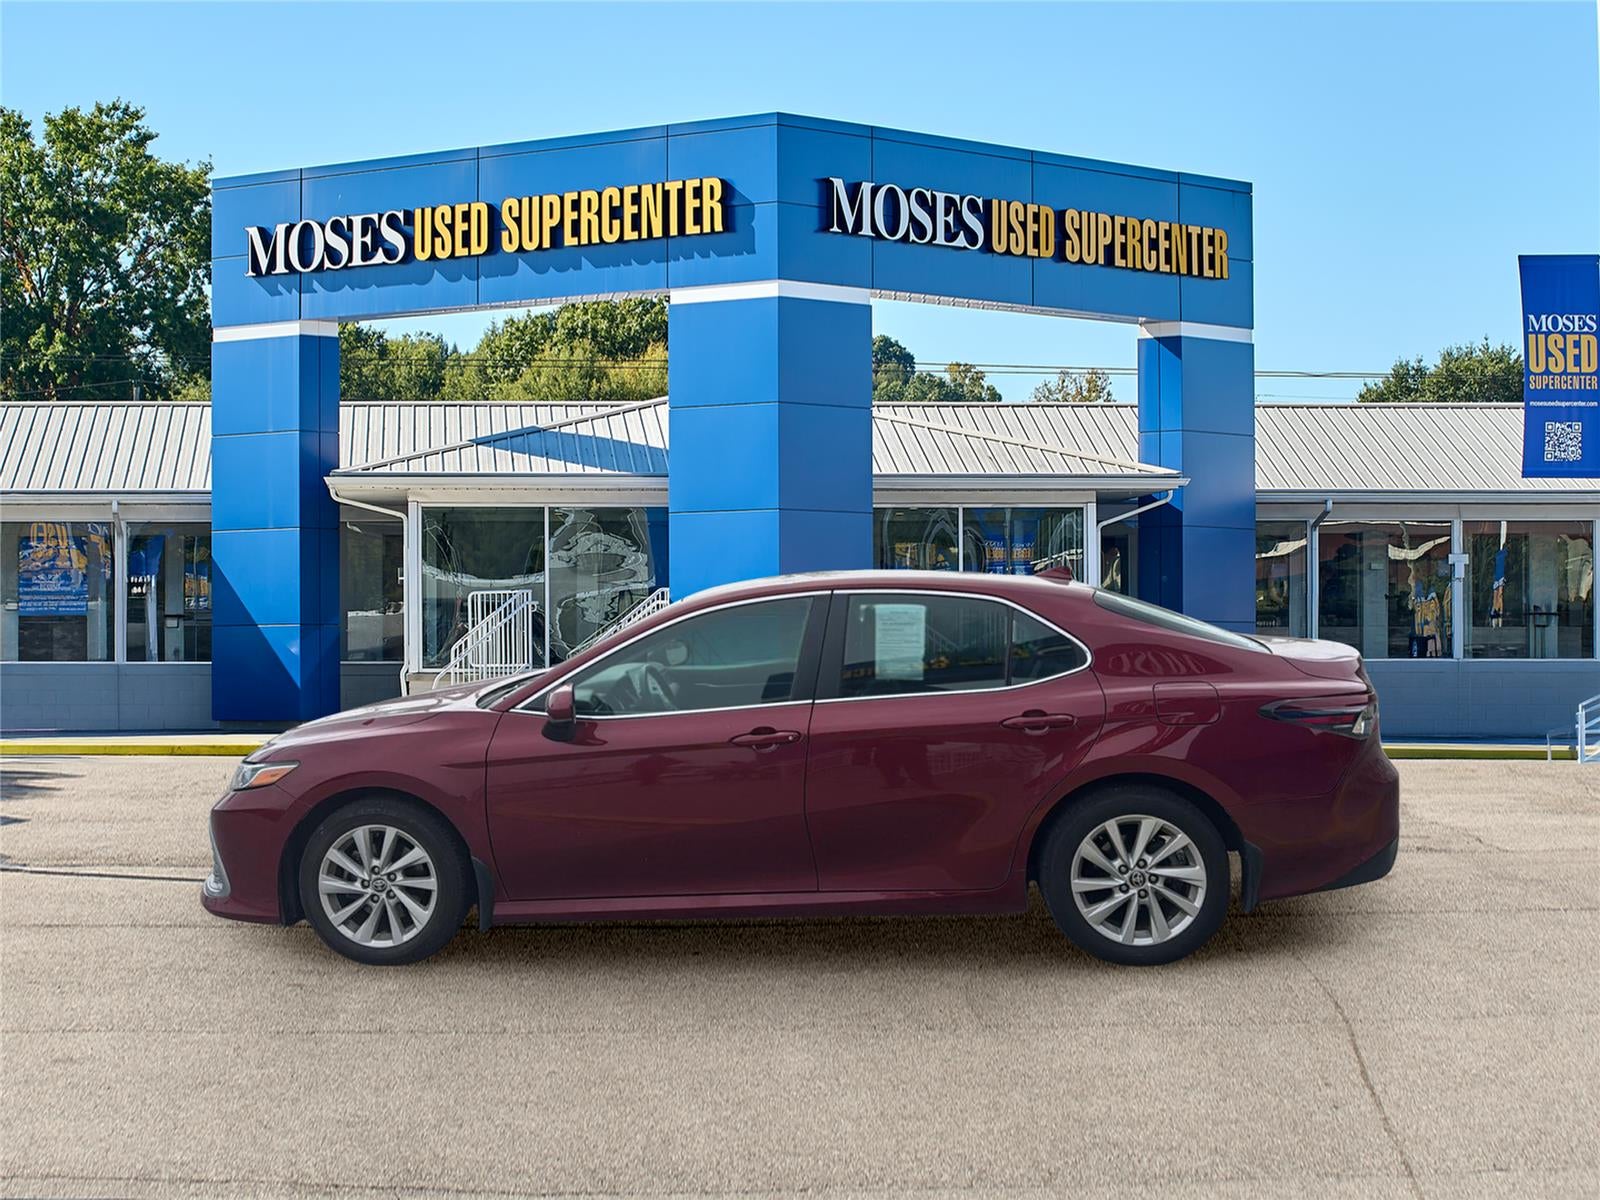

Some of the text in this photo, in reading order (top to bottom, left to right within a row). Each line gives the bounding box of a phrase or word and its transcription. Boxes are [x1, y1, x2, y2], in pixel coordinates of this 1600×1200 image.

[245, 177, 723, 277] MOSES USED SUPERCENTER
[828, 176, 1230, 279] MOSES USED SUPERCENTER
[1528, 314, 1597, 333] MOSES
[1528, 334, 1598, 373] USED
[1529, 375, 1598, 390] SUPERCENTER
